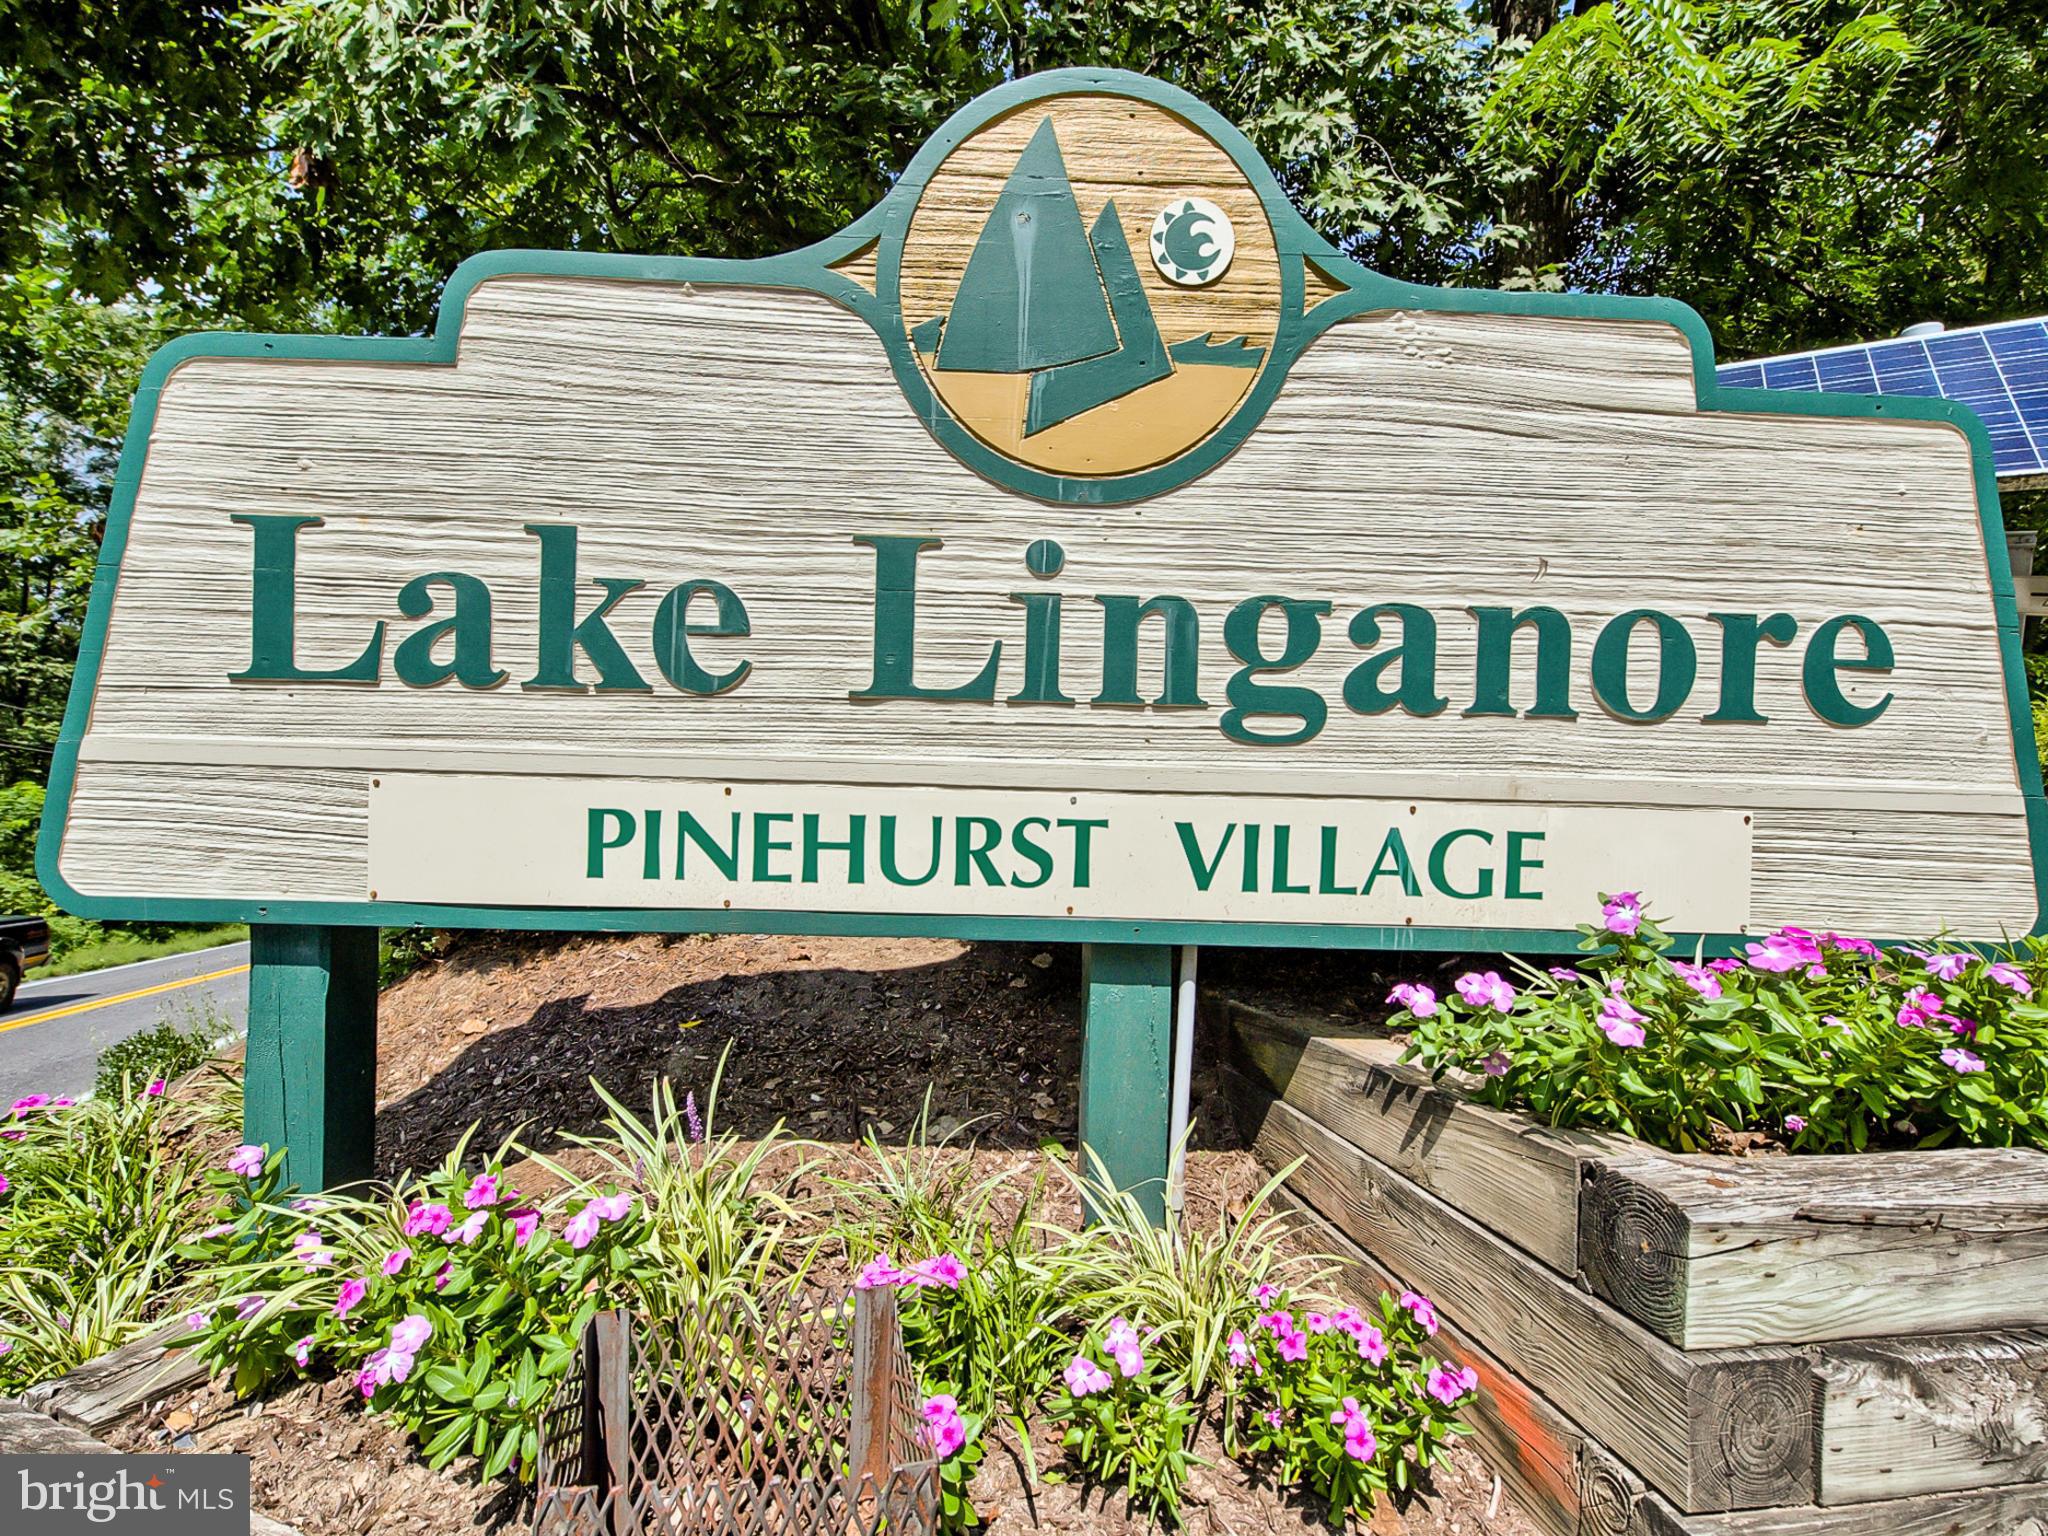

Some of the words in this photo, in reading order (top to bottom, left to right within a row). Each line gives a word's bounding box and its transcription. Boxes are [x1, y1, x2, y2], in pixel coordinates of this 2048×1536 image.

[228, 513, 754, 696] Lake
[849, 535, 1895, 746] Linganore
[586, 807, 1108, 889] PINEHURST
[1175, 822, 1545, 900] VILLAGE
